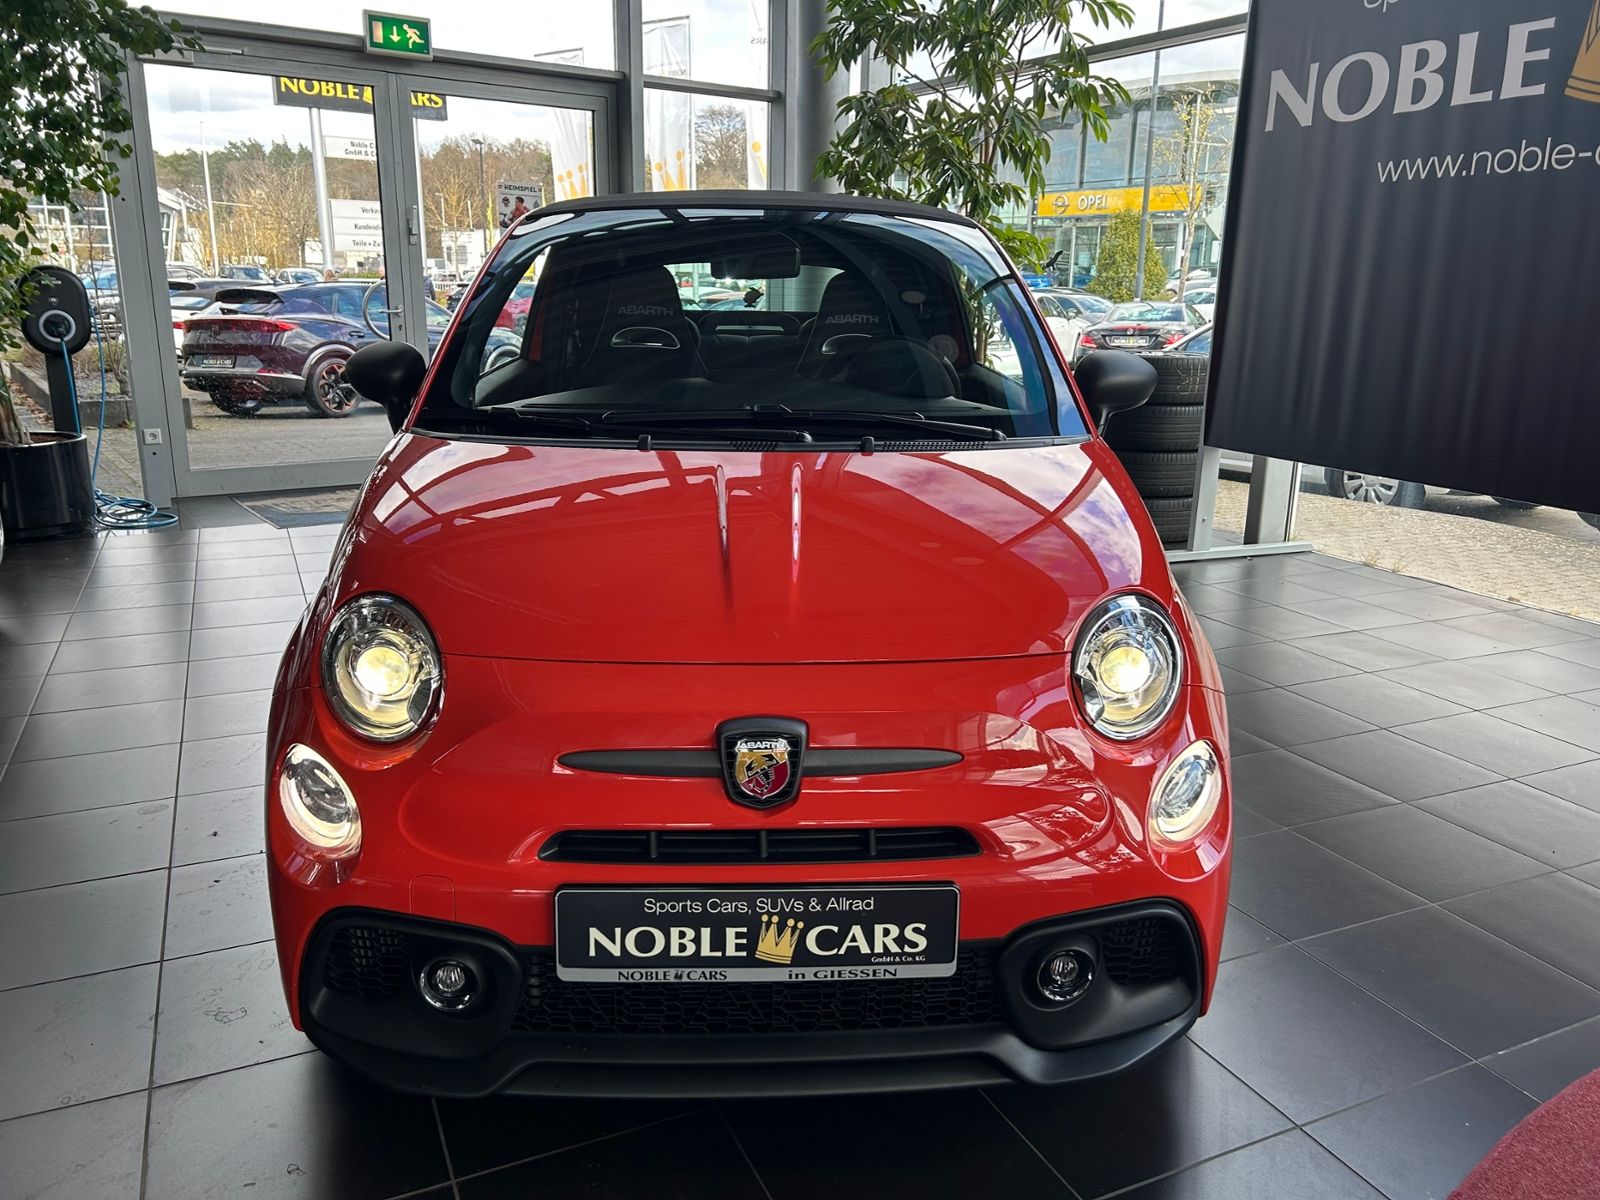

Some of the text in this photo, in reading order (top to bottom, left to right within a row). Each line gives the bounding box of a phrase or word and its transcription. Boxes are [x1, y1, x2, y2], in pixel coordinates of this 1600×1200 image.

[1265, 16, 1557, 132] NOBLE
[279, 76, 360, 100] NOBLE
[350, 141, 368, 149] Noble
[1377, 137, 1600, 183] www.noble-
[504, 184, 537, 193] HEIMSPIEL
[1078, 195, 1108, 211] OPEL
[618, 305, 674, 317] ABARTH
[825, 313, 880, 325] ABARTH
[739, 741, 785, 749] ABARTH
[644, 896, 874, 915] Sports Cars, SUVs & Allrad
[589, 922, 928, 957] NOBLE CARS
[618, 968, 898, 981] NOBLE CARS in GIESSEN
